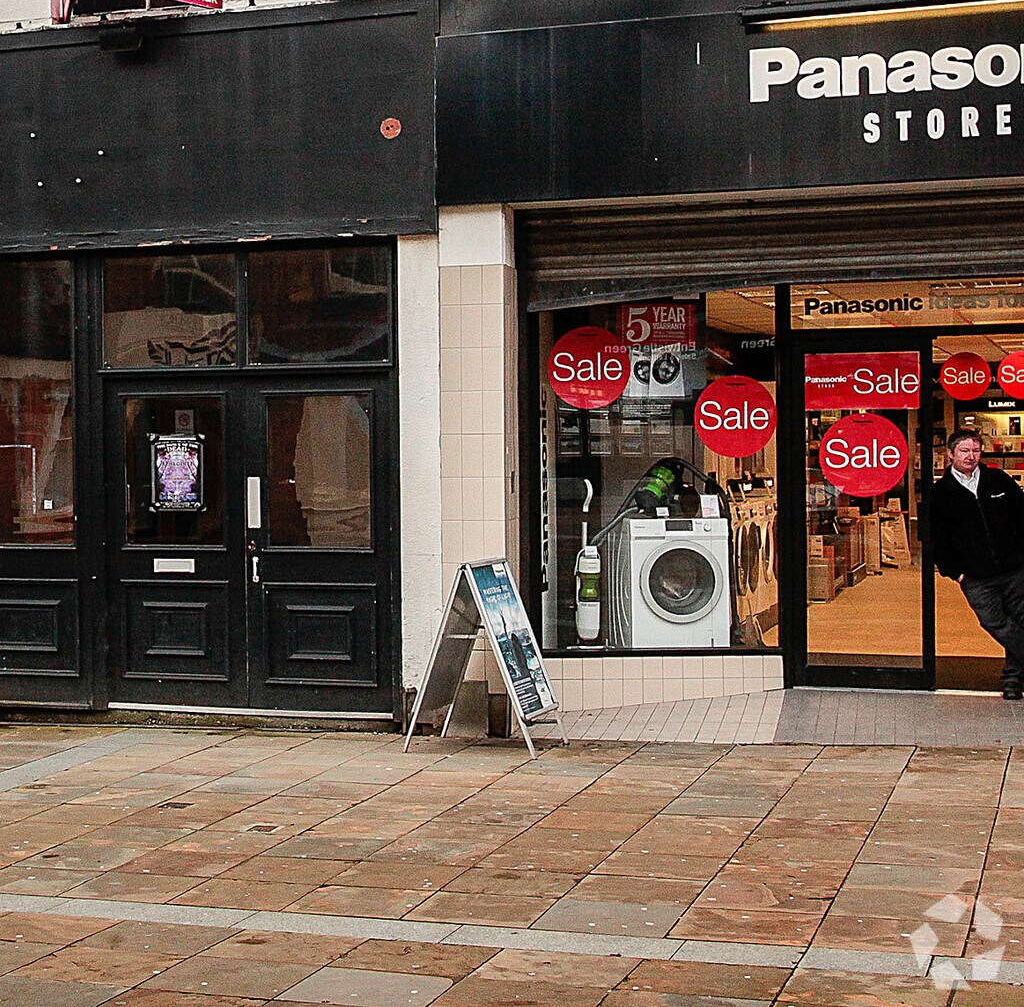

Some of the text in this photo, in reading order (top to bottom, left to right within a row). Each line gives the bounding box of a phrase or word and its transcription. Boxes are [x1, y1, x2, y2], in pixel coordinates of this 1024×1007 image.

[748, 43, 1024, 104] Panaso
[862, 103, 1013, 144] STORE
[804, 294, 924, 316] Panasonic
[626, 307, 652, 344] 5
[652, 306, 686, 323] YEAR
[552, 352, 623, 382] Sale
[852, 367, 919, 395] Sale
[943, 367, 986, 385] Sale
[699, 400, 770, 431] Sale
[824, 438, 901, 469] Sale
